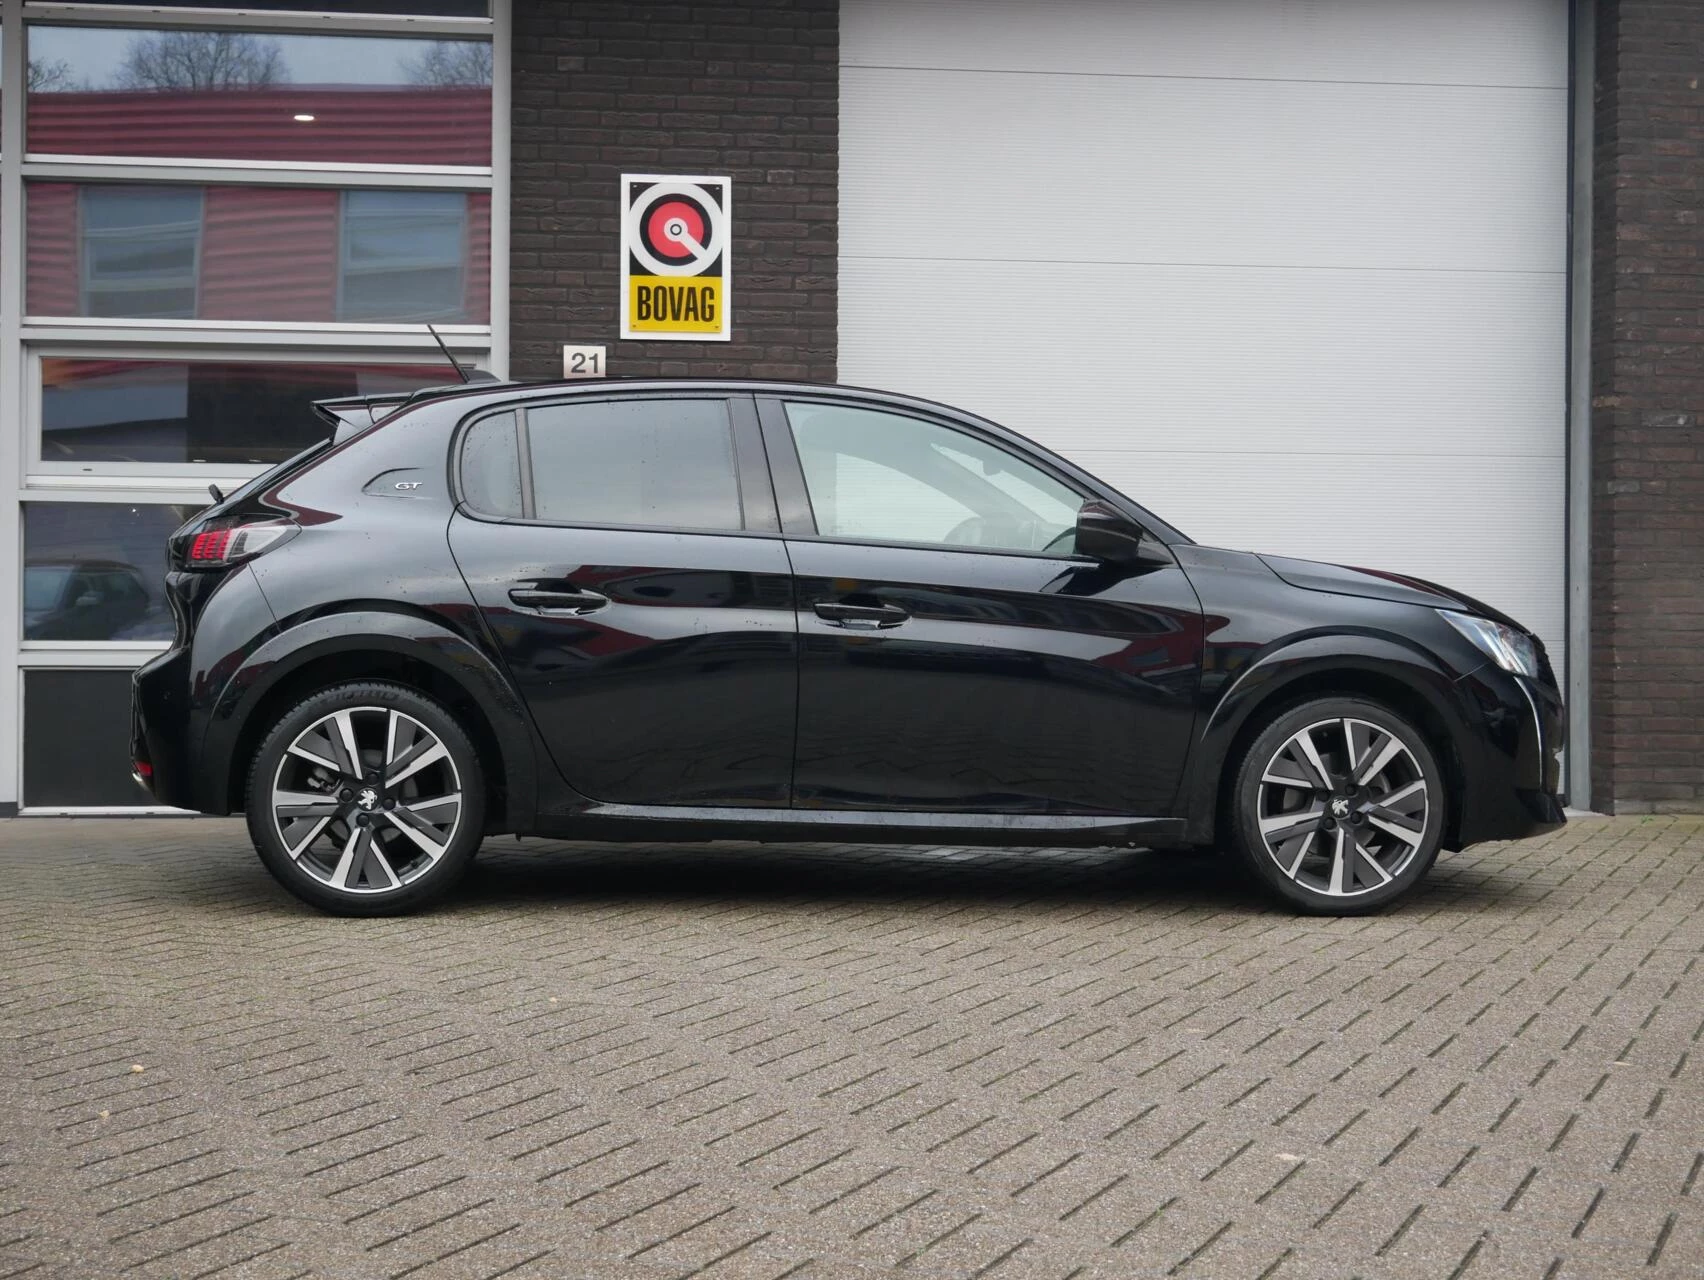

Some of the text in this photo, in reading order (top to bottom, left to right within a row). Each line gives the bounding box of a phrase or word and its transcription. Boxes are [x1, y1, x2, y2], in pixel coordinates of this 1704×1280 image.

[637, 286, 715, 322] BOVAG
[571, 353, 599, 374] 21
[394, 482, 423, 491] GT
